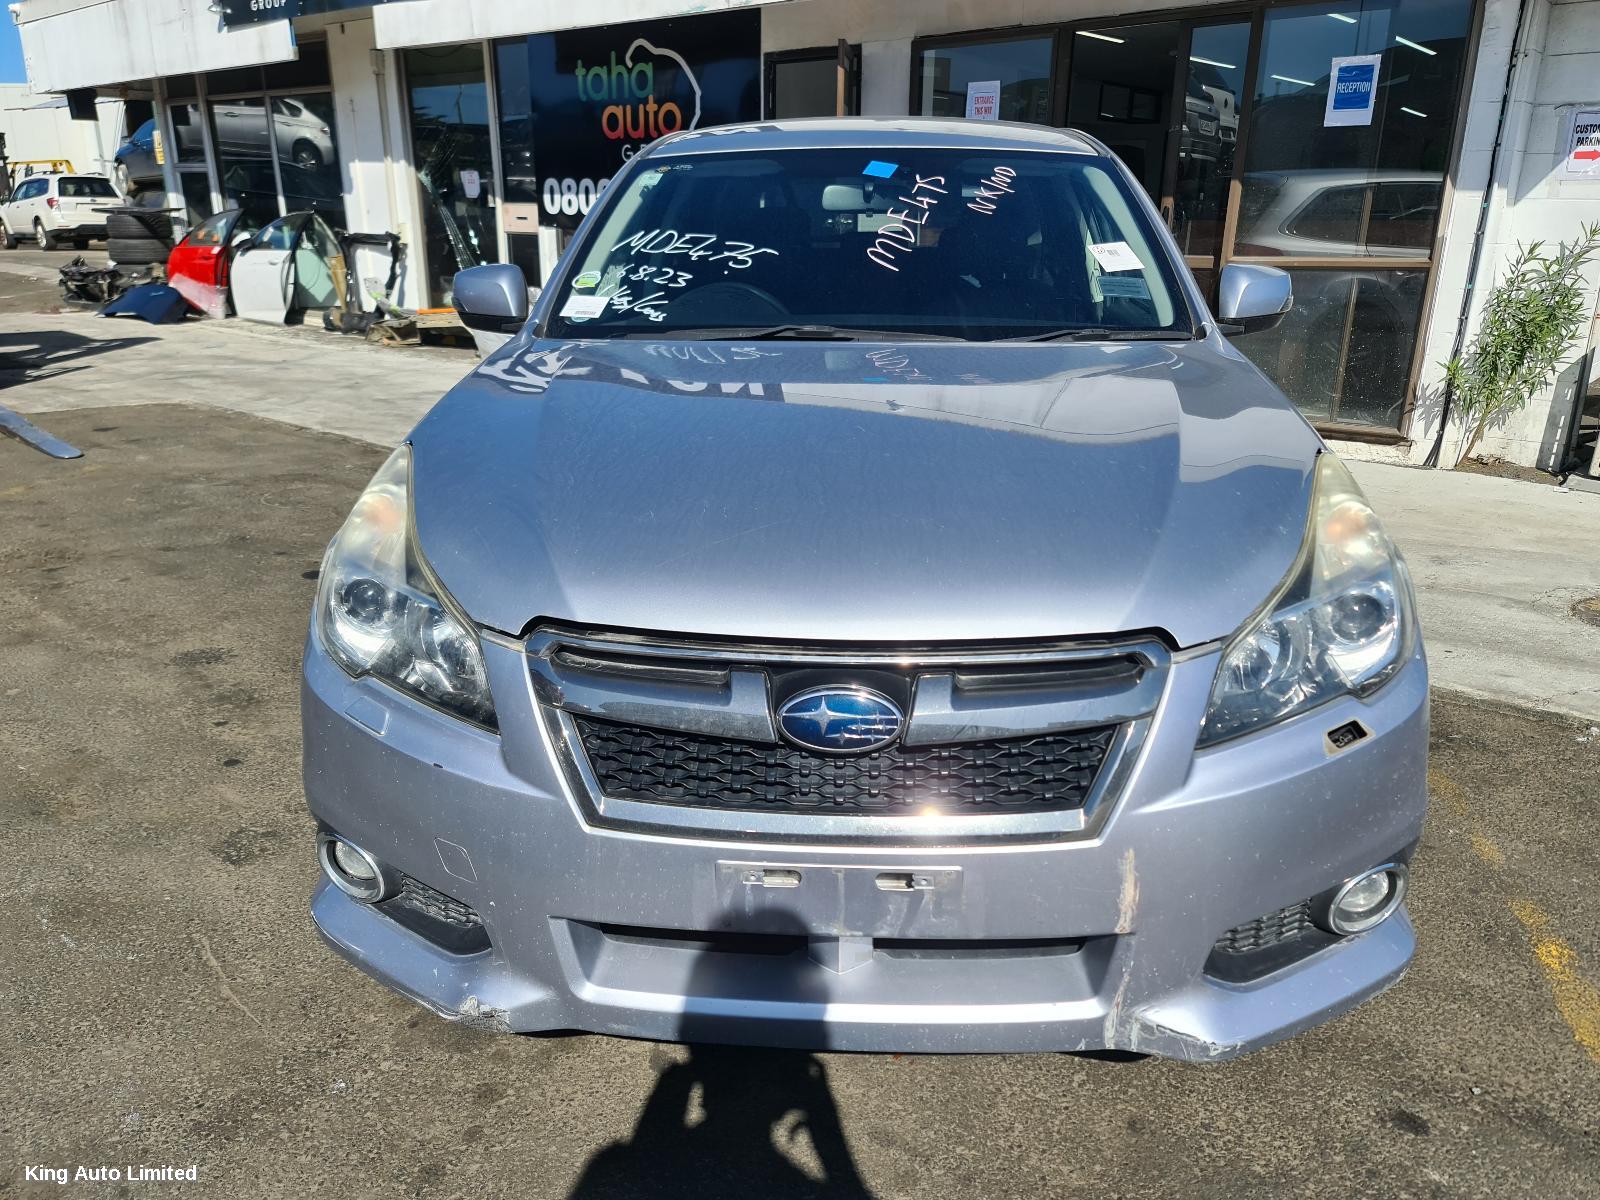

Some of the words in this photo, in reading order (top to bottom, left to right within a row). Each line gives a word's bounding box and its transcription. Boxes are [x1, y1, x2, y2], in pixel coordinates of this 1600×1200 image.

[575, 51, 654, 102] taha
[1336, 81, 1371, 94] RECEPTION
[601, 95, 682, 139] auto
